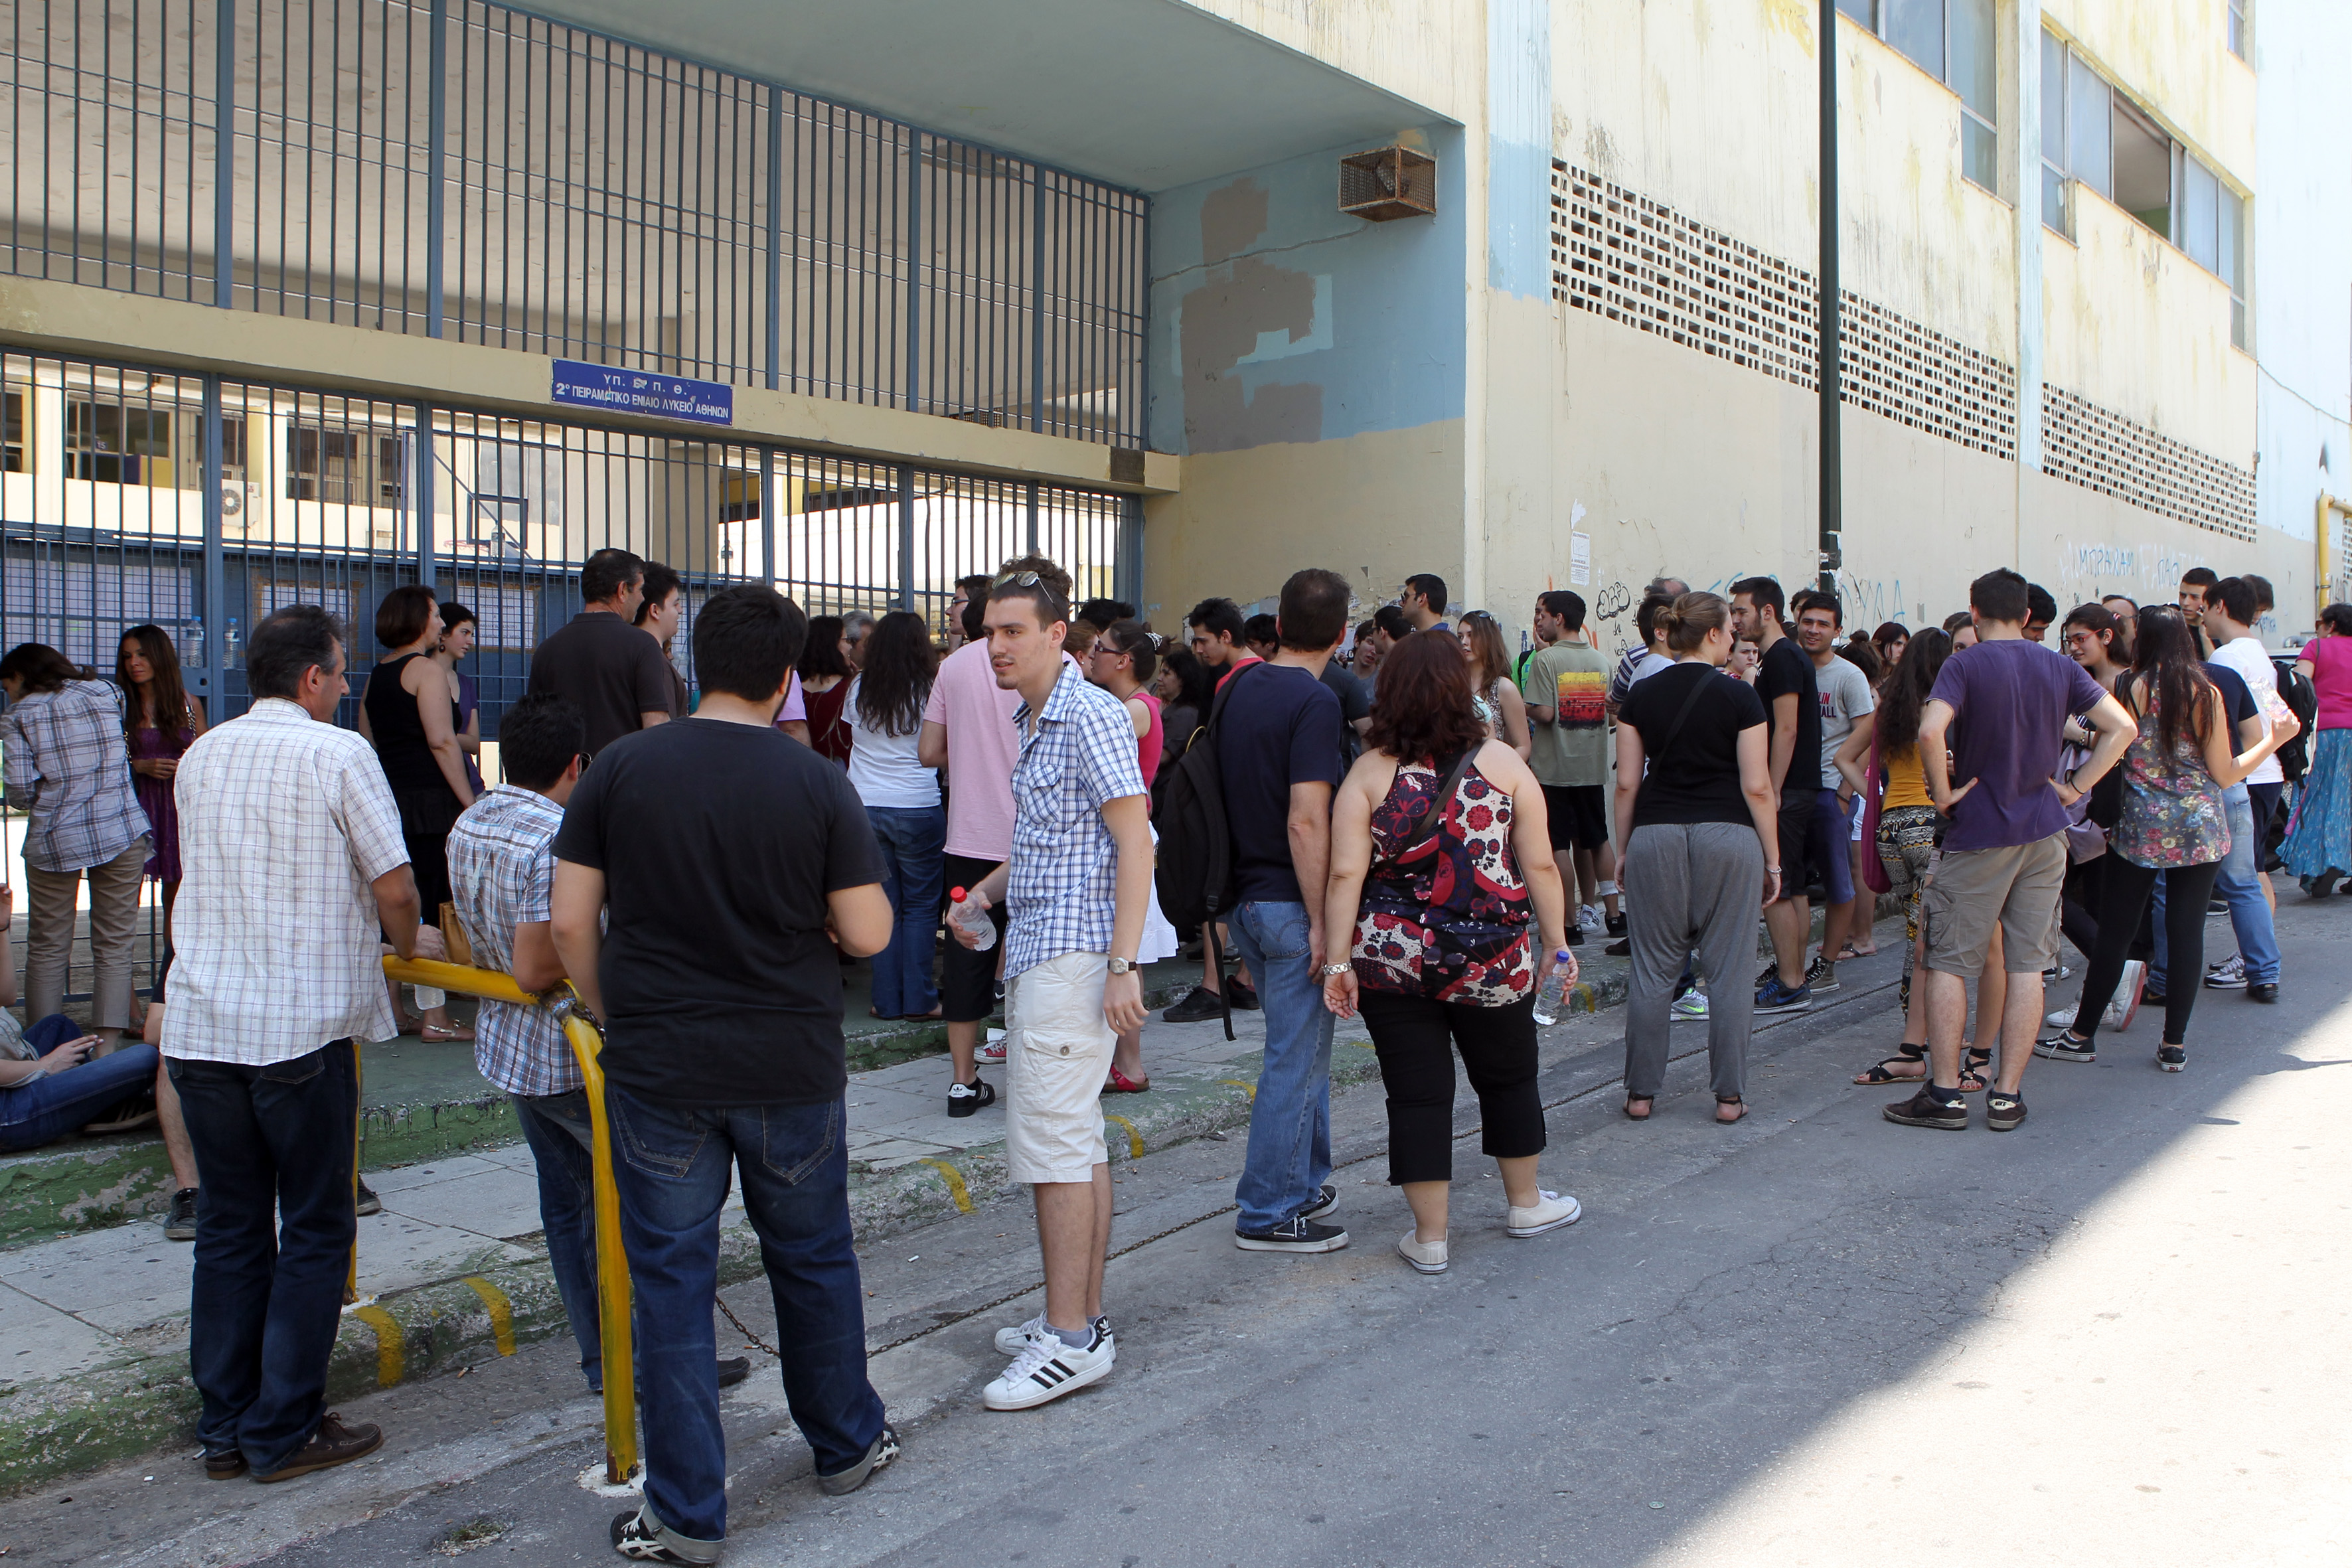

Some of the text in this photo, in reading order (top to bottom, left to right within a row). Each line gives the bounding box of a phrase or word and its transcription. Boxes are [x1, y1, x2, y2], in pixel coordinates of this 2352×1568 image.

[632, 394, 660, 409] ΕΝΙΑΙΟ
[662, 398, 693, 414] ΛΥΚΕΙΟ
[695, 403, 729, 419] ΑΘΗΝΩΝ
